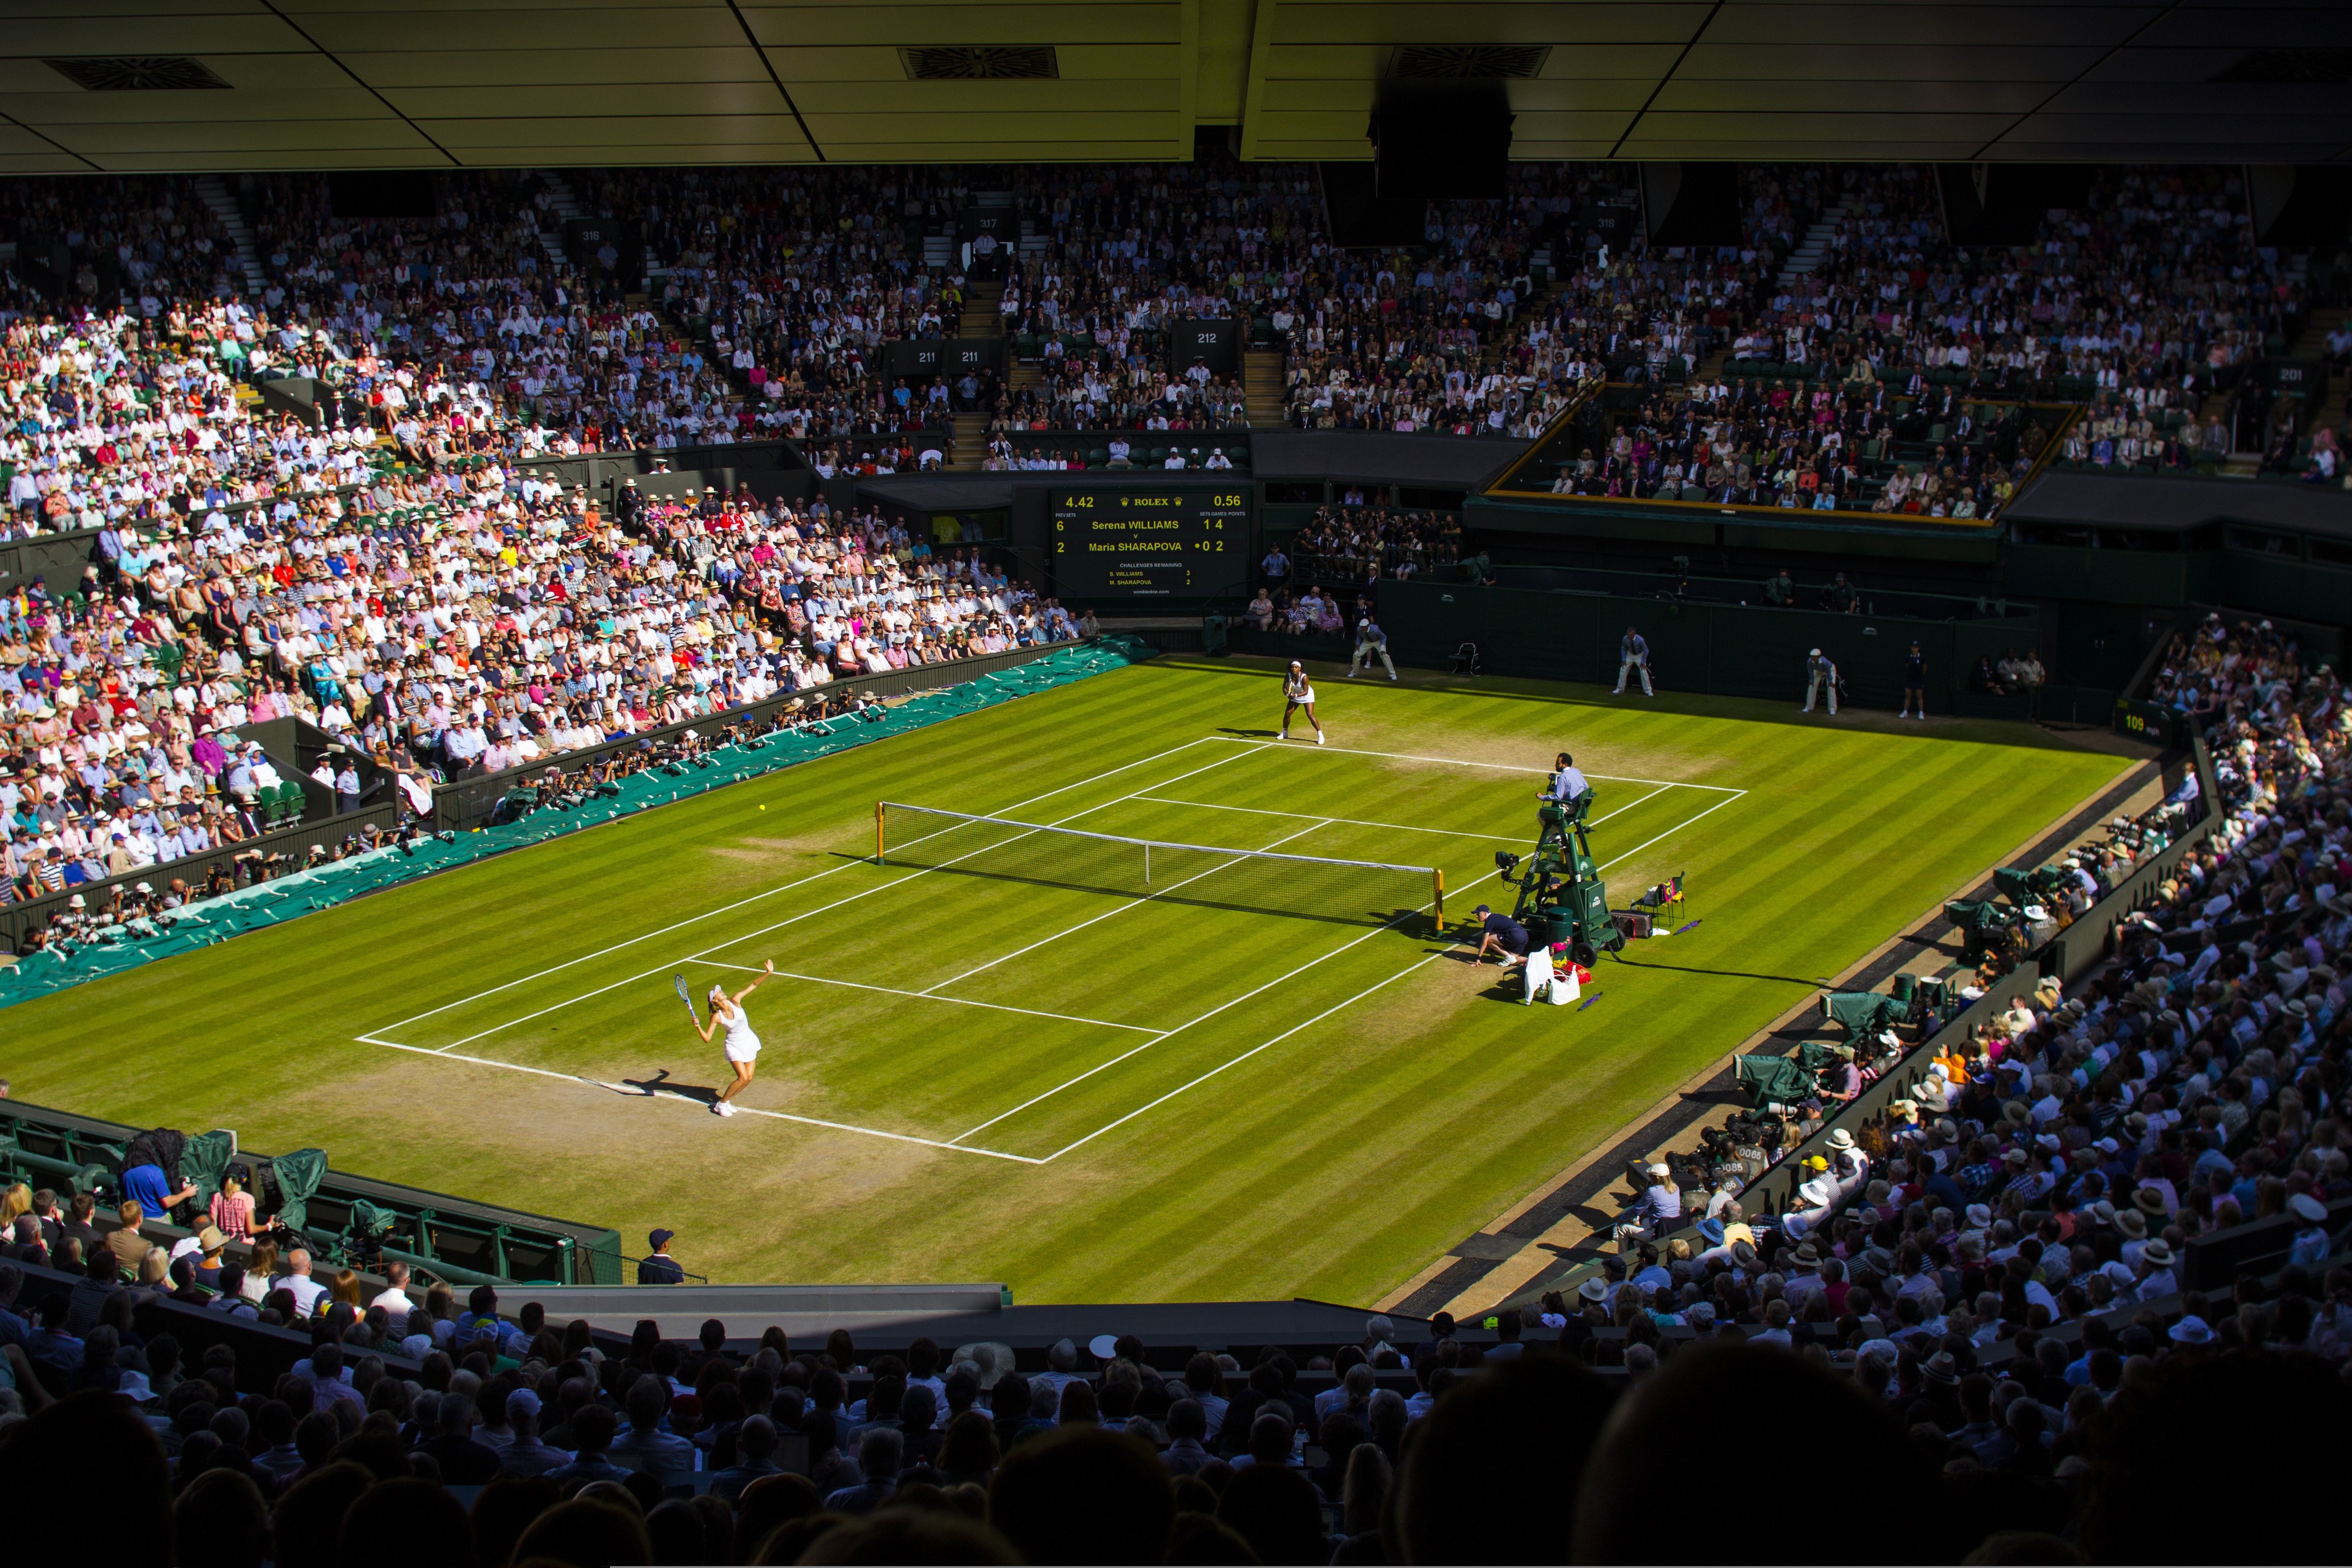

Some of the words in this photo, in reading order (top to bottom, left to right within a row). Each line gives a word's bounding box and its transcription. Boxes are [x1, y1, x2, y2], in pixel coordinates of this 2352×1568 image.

[980, 219, 997, 228] 317
[1599, 219, 1615, 228] 318
[583, 231, 599, 240] 316
[1198, 333, 1216, 343] 212
[919, 352, 935, 362] 211
[962, 352, 977, 361] 211
[2280, 368, 2303, 381] 201
[1066, 496, 1094, 508] 4.42
[1214, 496, 1240, 506] 0.56
[1056, 520, 1064, 531] 6
[1092, 521, 1126, 529] Serena
[1128, 520, 1179, 529] WILLIAMS
[1204, 519, 1209, 529] 1
[1215, 519, 1223, 529] 4
[1057, 542, 1064, 552] 2
[1089, 543, 1115, 551] Maria
[1118, 543, 1182, 551] SHARAPOVA
[1202, 541, 1210, 551] 0
[1216, 541, 1223, 551] 2
[2126, 713, 2144, 732] 109
[1739, 1148, 1761, 1160] 0065
